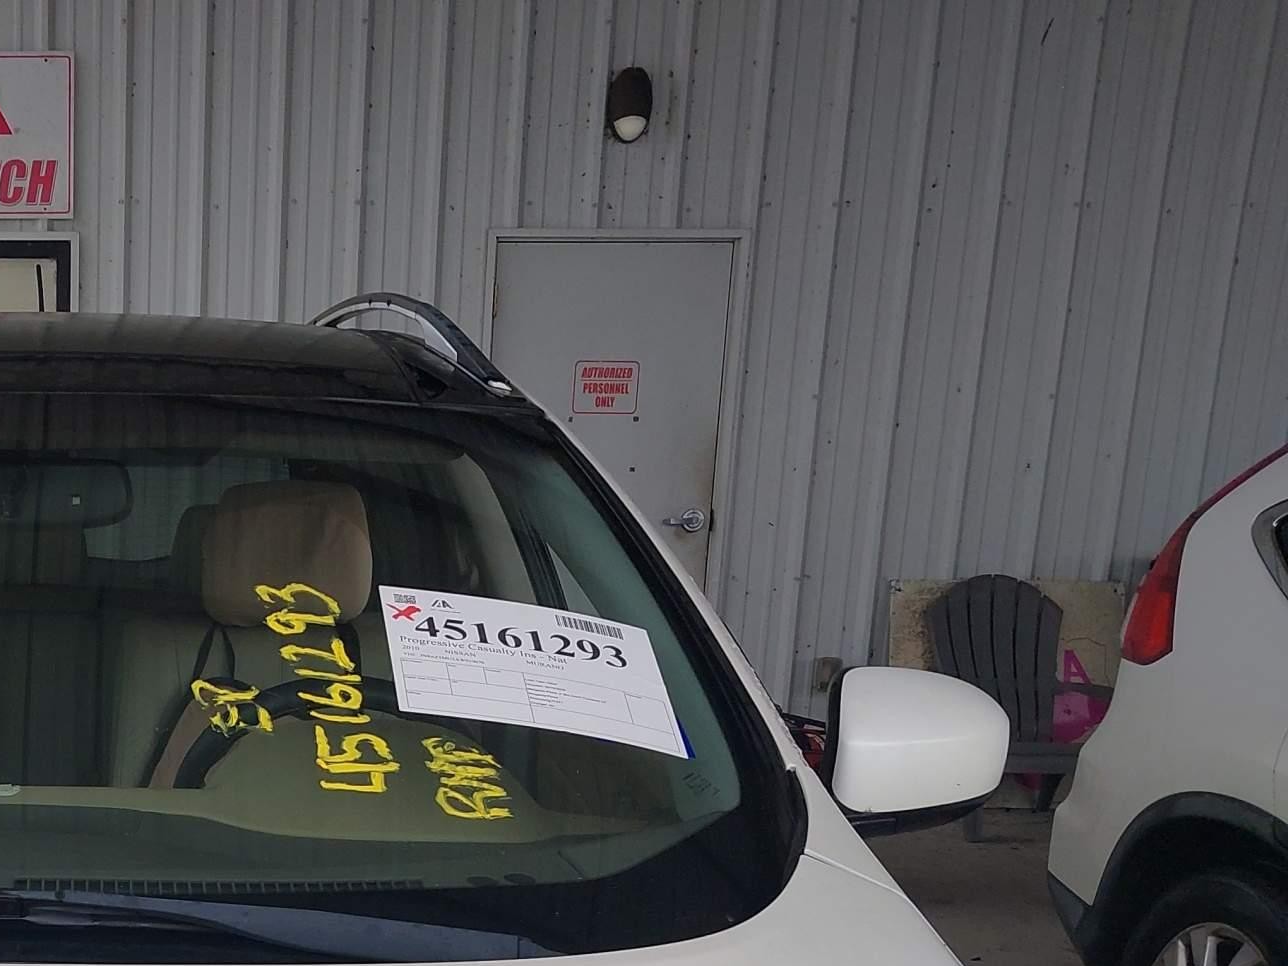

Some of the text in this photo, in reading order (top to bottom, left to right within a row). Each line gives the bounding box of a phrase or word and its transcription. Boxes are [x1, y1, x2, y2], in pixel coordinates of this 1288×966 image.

[581, 367, 633, 379] AUTHORIZED
[582, 382, 629, 394] PERSONNEL
[594, 396, 615, 408] ONLY
[399, 635, 465, 650] Progressive
[467, 643, 516, 657] Casualty
[520, 650, 537, 660] Ins
[415, 616, 628, 669] 45161293
[254, 582, 401, 793] 45161293
